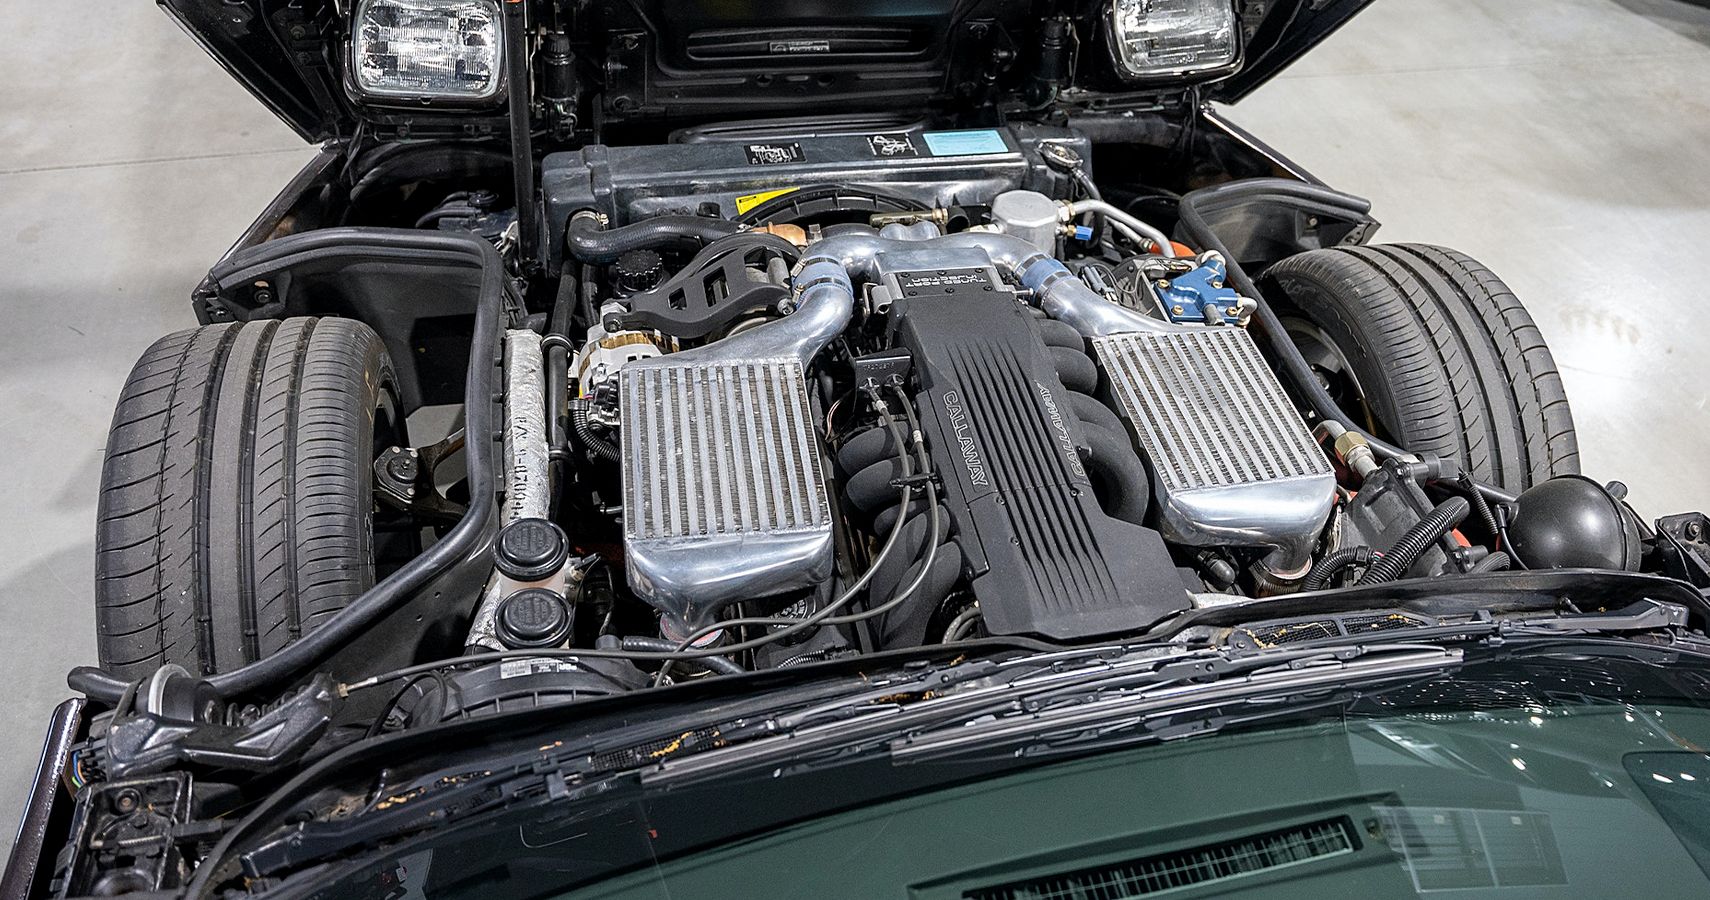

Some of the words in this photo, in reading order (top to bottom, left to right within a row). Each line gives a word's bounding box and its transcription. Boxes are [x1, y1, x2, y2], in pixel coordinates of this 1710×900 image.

[911, 274, 978, 282] INJECTION
[943, 391, 989, 487] CALLAWAY
[1037, 382, 1085, 477] CALLAWAY
